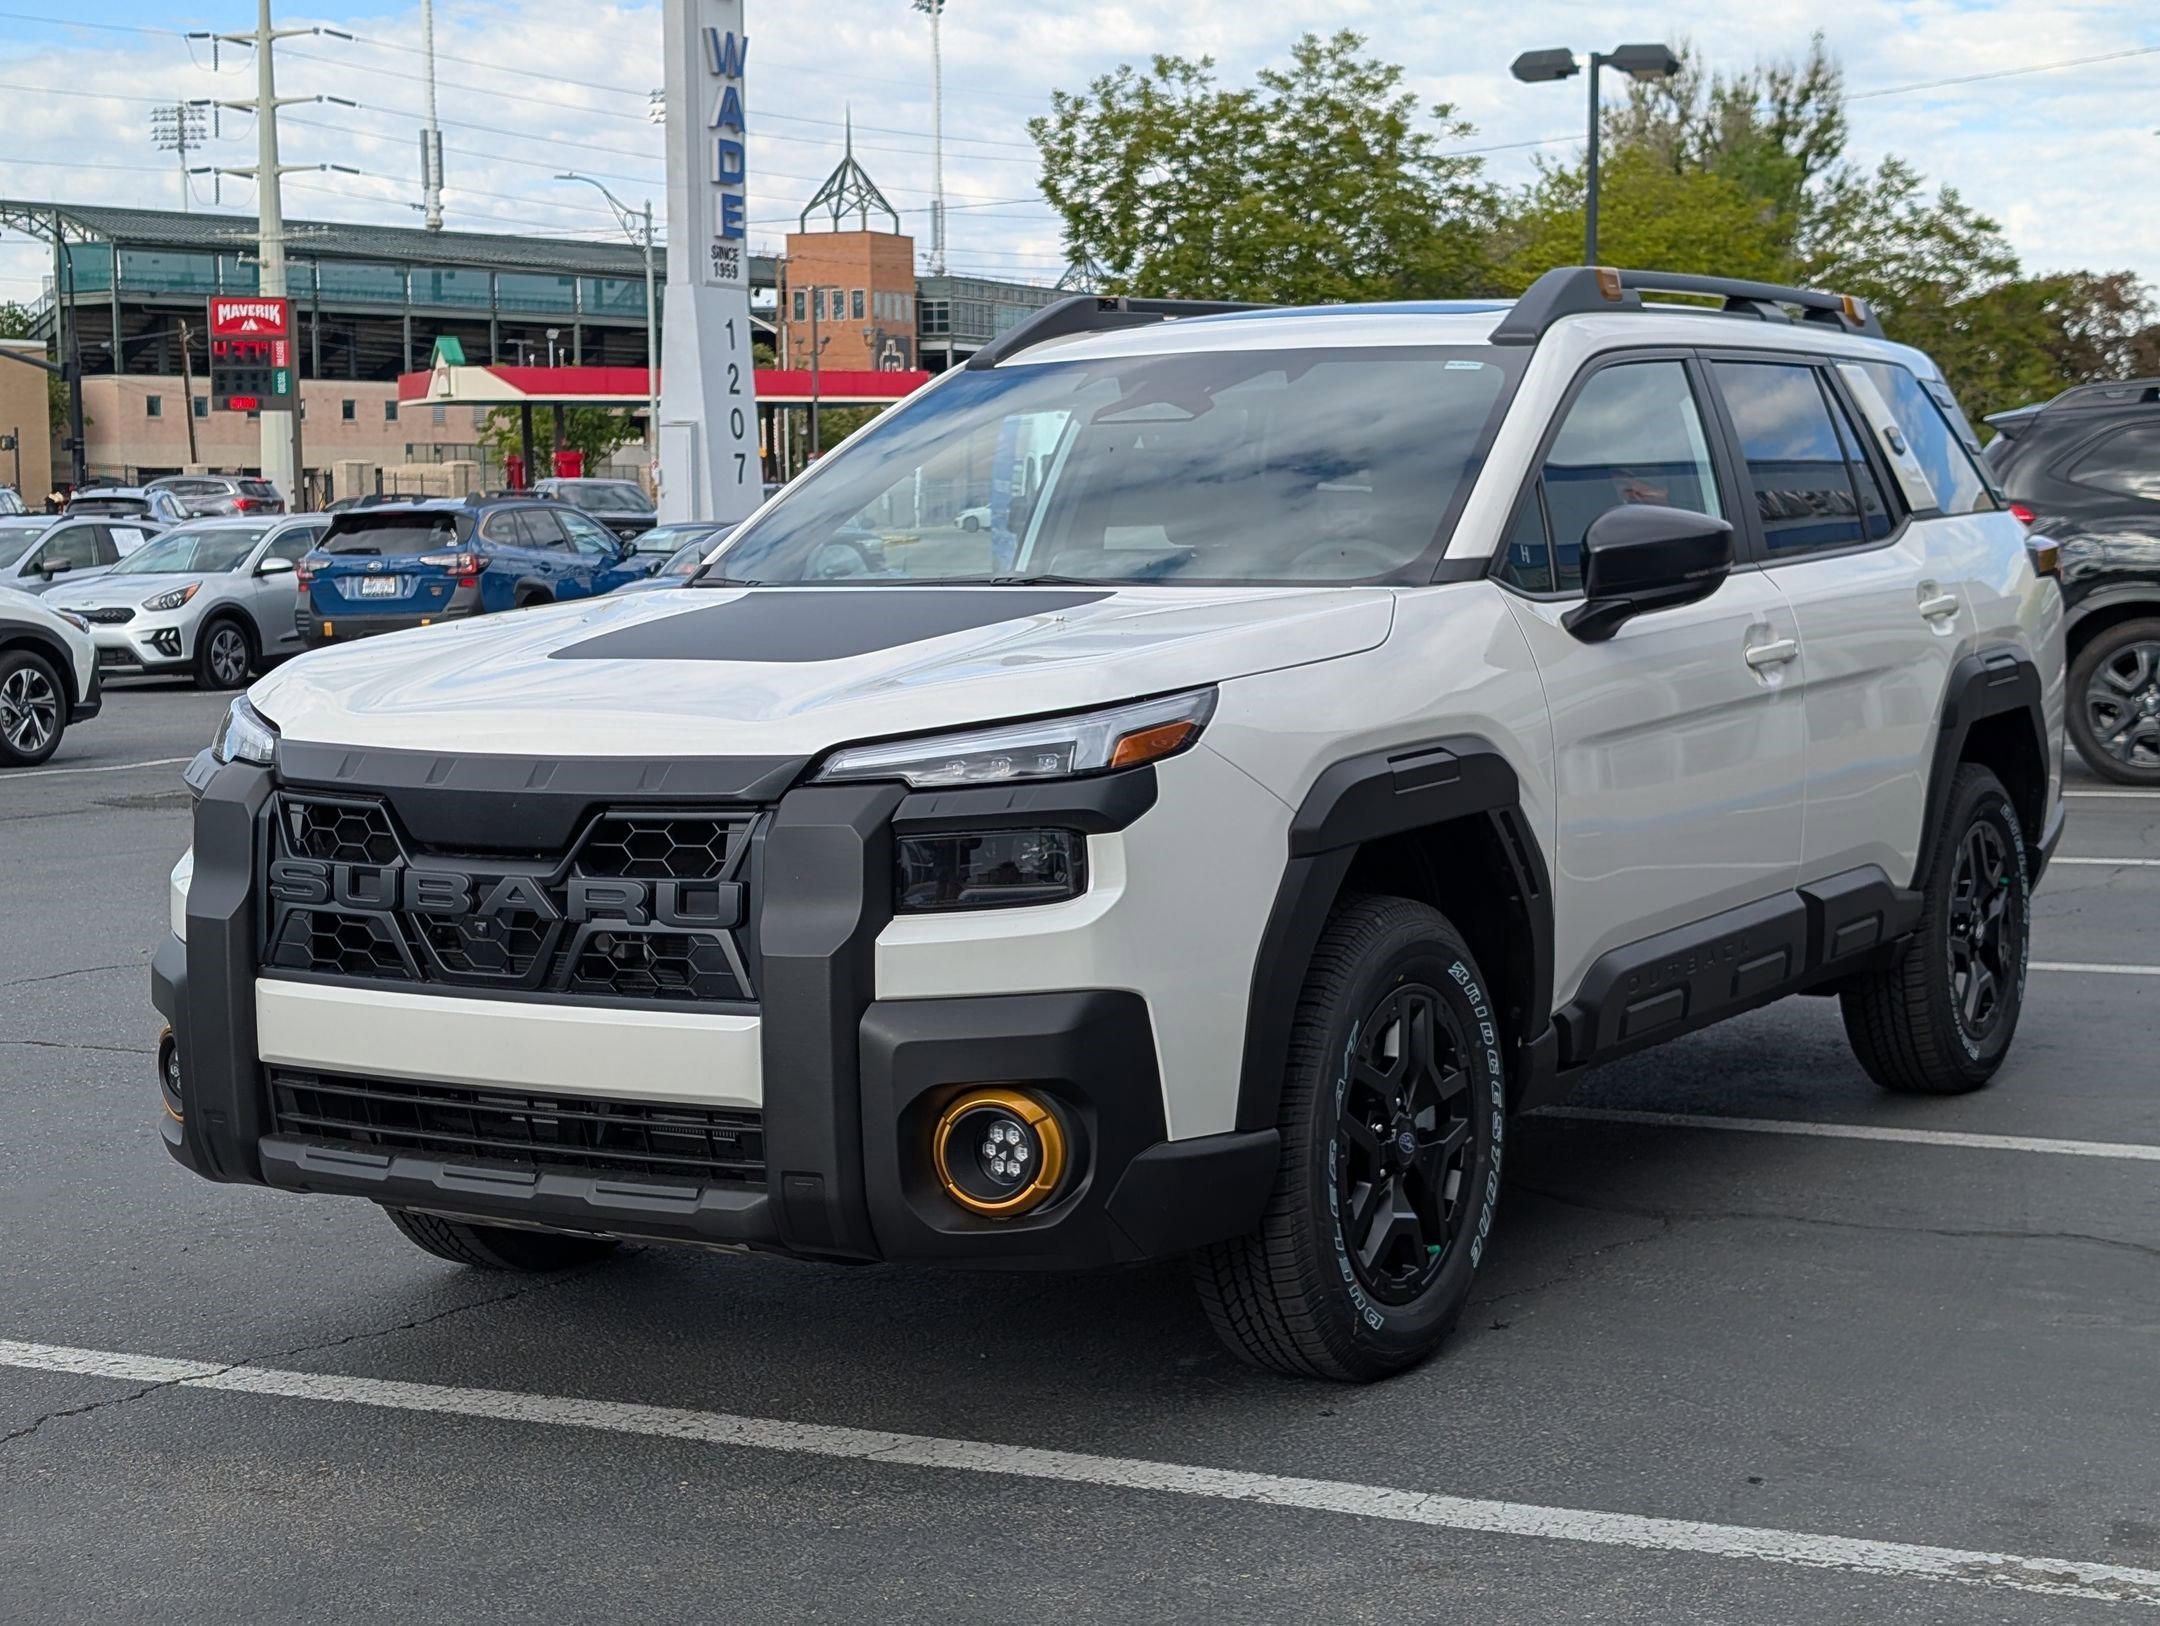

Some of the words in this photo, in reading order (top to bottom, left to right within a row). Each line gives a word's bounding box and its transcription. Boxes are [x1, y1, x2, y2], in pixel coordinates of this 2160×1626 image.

[704, 27, 748, 240] WADE
[711, 245, 740, 262] SINCE
[713, 261, 739, 279] 1959
[218, 304, 280, 326] MAVERIK
[725, 318, 746, 485] 1207
[269, 858, 745, 930] SUBARU
[1447, 961, 1504, 1269] BRIDGESTONE
[1328, 1138, 1385, 1331] DUELER
